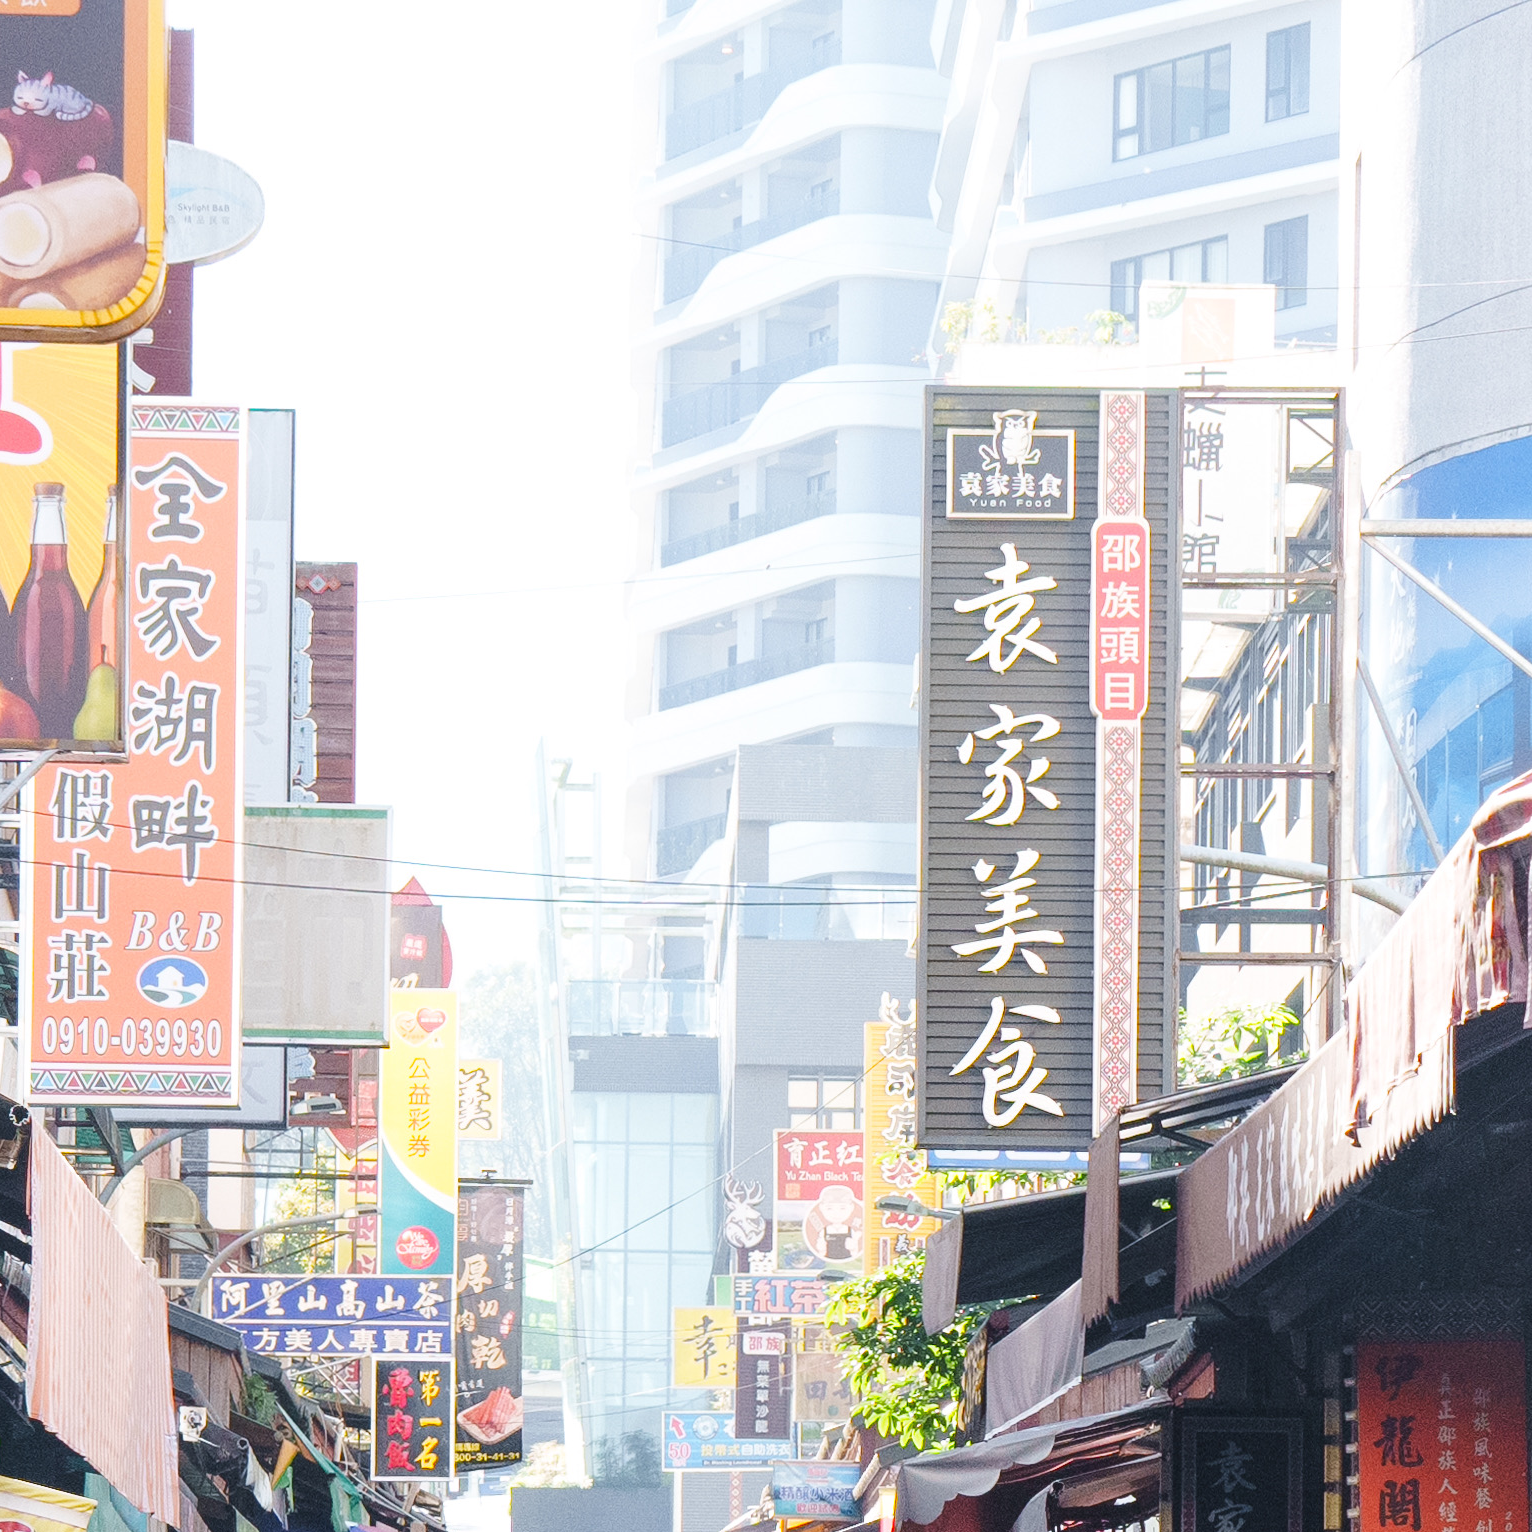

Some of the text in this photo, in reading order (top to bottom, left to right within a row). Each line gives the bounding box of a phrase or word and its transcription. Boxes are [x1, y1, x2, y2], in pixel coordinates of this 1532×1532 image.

[177, 203, 230, 214] Skylight B&B
[959, 472, 1062, 498] 袁家美食
[970, 498, 1051, 508] Yuan Food
[1100, 534, 1141, 710] 邵族頭目
[133, 450, 227, 886] 全家湖畔
[950, 543, 1066, 1128] 袁家美食
[50, 769, 110, 1002] 假山莊
[124, 909, 222, 953] B&B
[41, 1016, 223, 1057] 0910-039930
[408, 1057, 431, 1158] 公益彩券
[824, 1170, 848, 1182] Black
[220, 1280, 444, 1319] 阿里山高山茶
[382, 1367, 416, 1471] 魯肉飯
[414, 1370, 443, 1471] 第一名
[669, 1442, 692, 1460] 50
